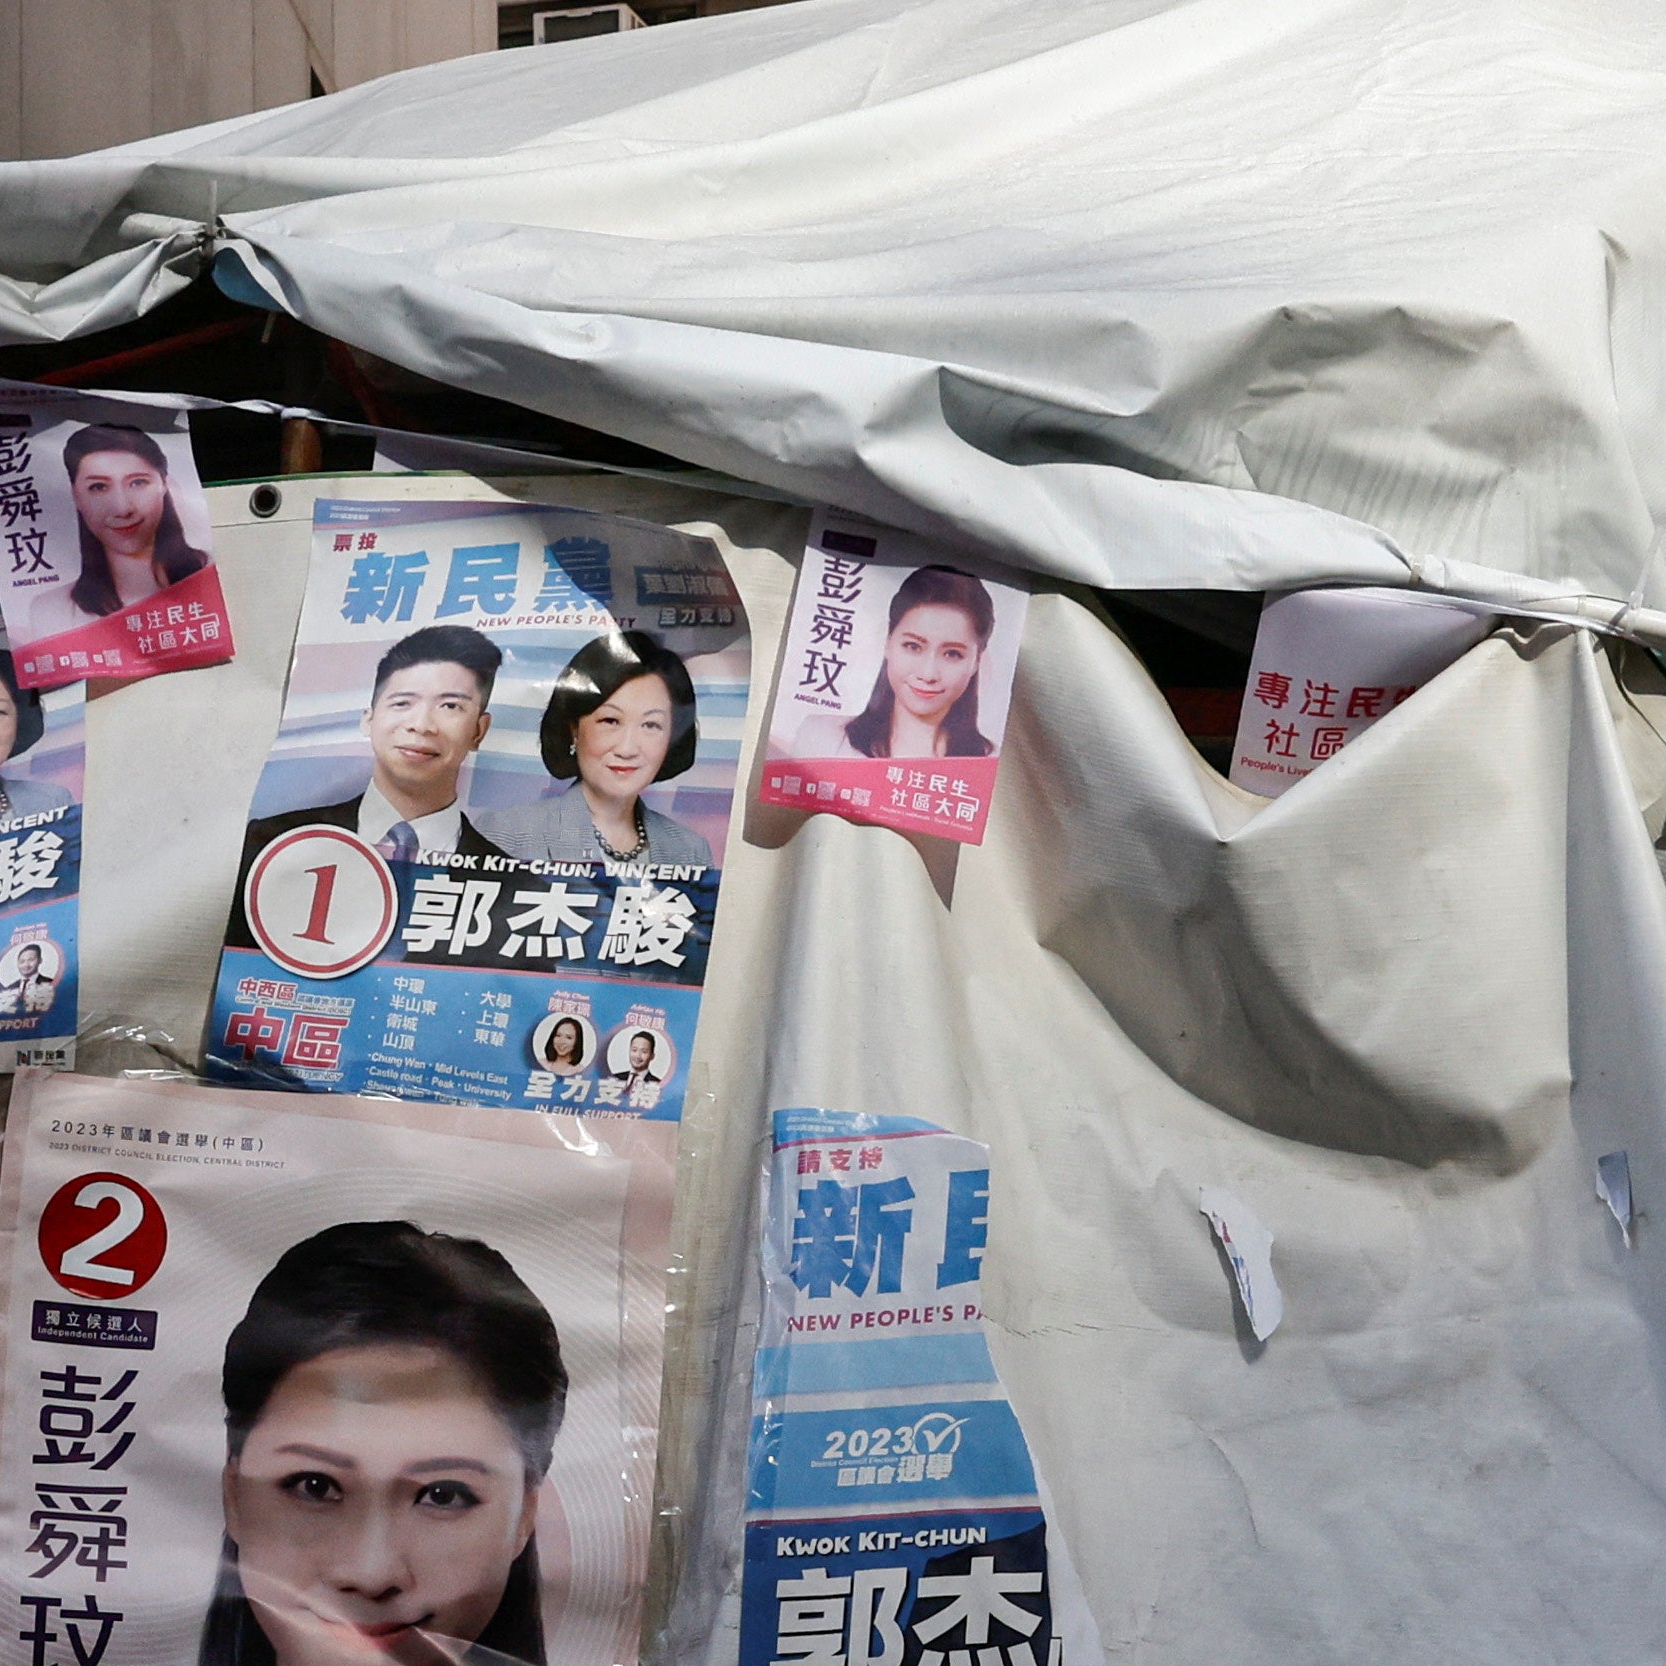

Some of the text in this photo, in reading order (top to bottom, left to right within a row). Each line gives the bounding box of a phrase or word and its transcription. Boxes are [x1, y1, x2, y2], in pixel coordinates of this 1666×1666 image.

[339, 535, 616, 625] 新民黨
[476, 613, 637, 630] NEW PEOPLE'S PARTY
[798, 557, 866, 697] 彭舜玟
[886, 766, 971, 798] 專注民生
[890, 788, 979, 823] 社區大同
[415, 847, 707, 883] KWOK KIT-CHUN, VINCENT
[291, 862, 338, 946] 1
[401, 877, 698, 969] 郭杰駿
[224, 1005, 351, 1071] 中區
[523, 1070, 661, 1111] 全力支持
[50, 1118, 266, 1152] 2023年區議會選舉(中區)
[797, 1146, 884, 1175] 請支持
[58, 1180, 145, 1287] 2
[43, 1308, 144, 1335] 獨立候選人
[787, 1304, 955, 1334] NEW PEOPLE'S
[822, 1426, 914, 1459] 2023
[837, 1453, 954, 1487] 區議會選舉
[776, 1526, 987, 1557] KWOK KIT-CHUN
